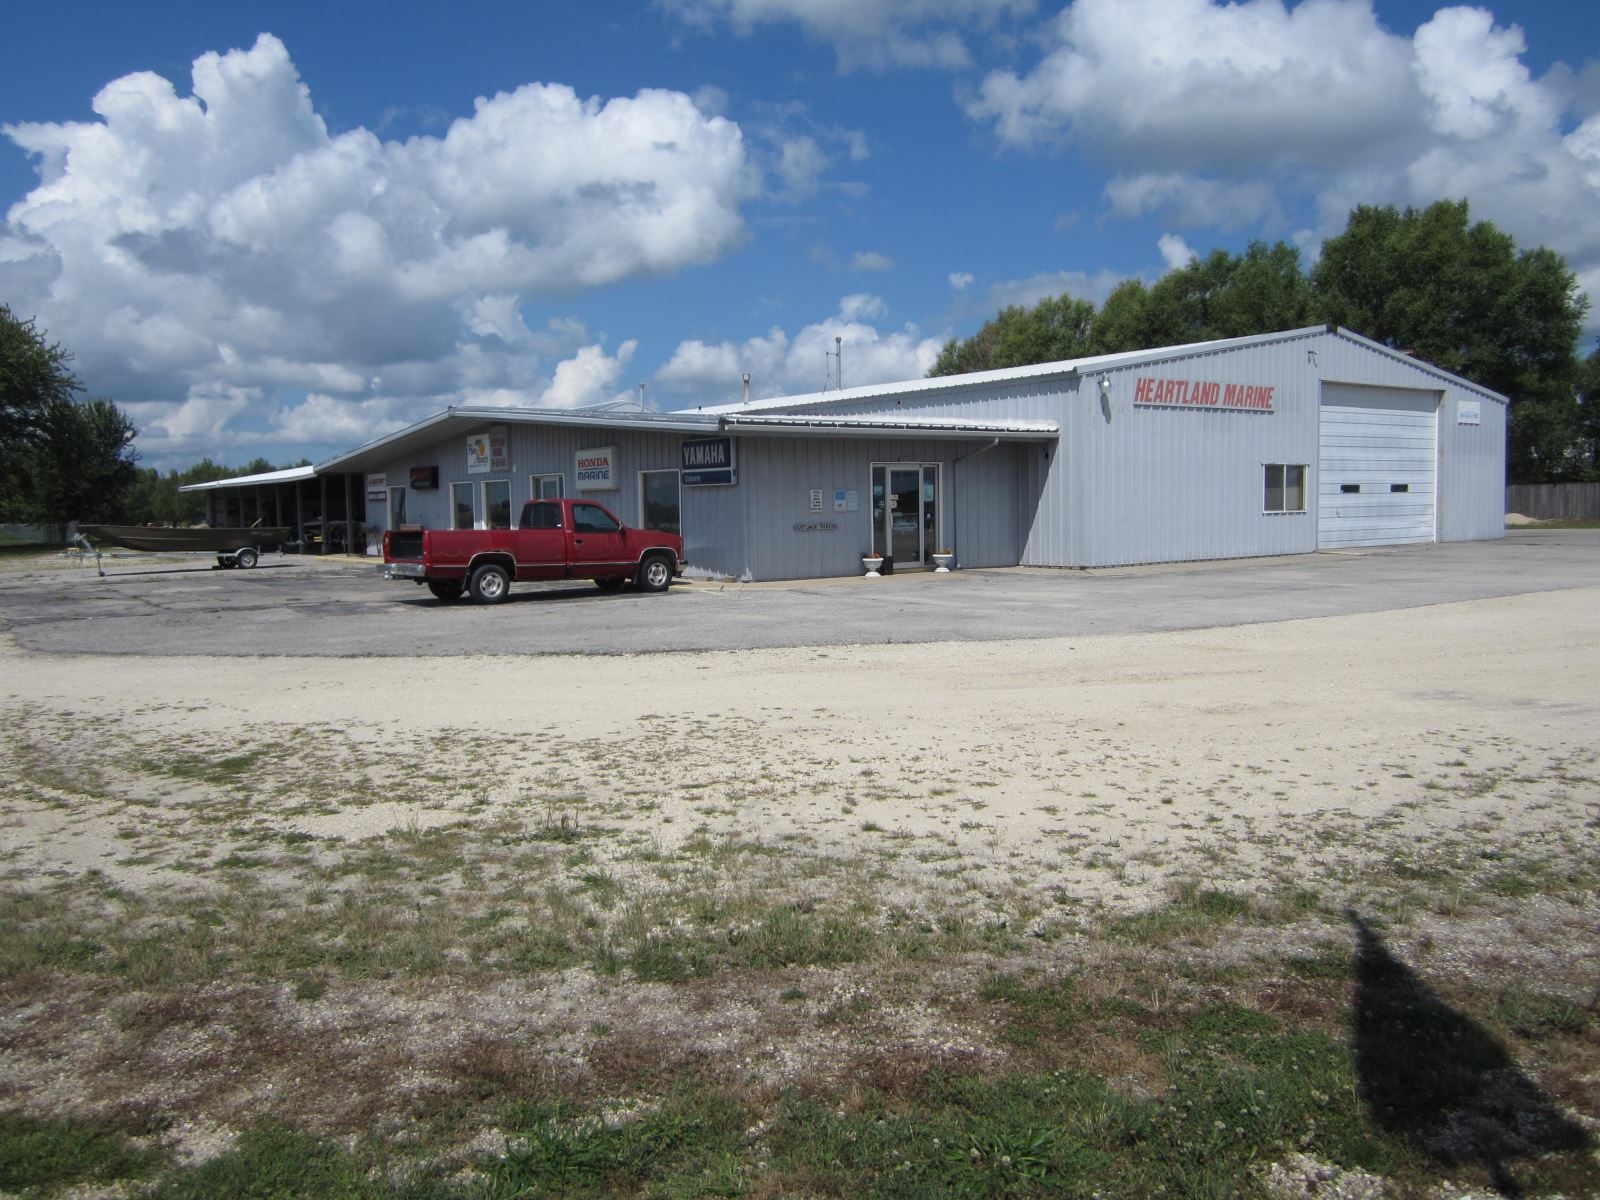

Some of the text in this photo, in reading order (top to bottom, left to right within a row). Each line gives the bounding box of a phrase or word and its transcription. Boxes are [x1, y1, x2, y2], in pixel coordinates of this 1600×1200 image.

[1134, 378, 1275, 409] HEARTLAND MARINE
[577, 456, 609, 469] HONDA
[683, 443, 725, 466] YAMAHA
